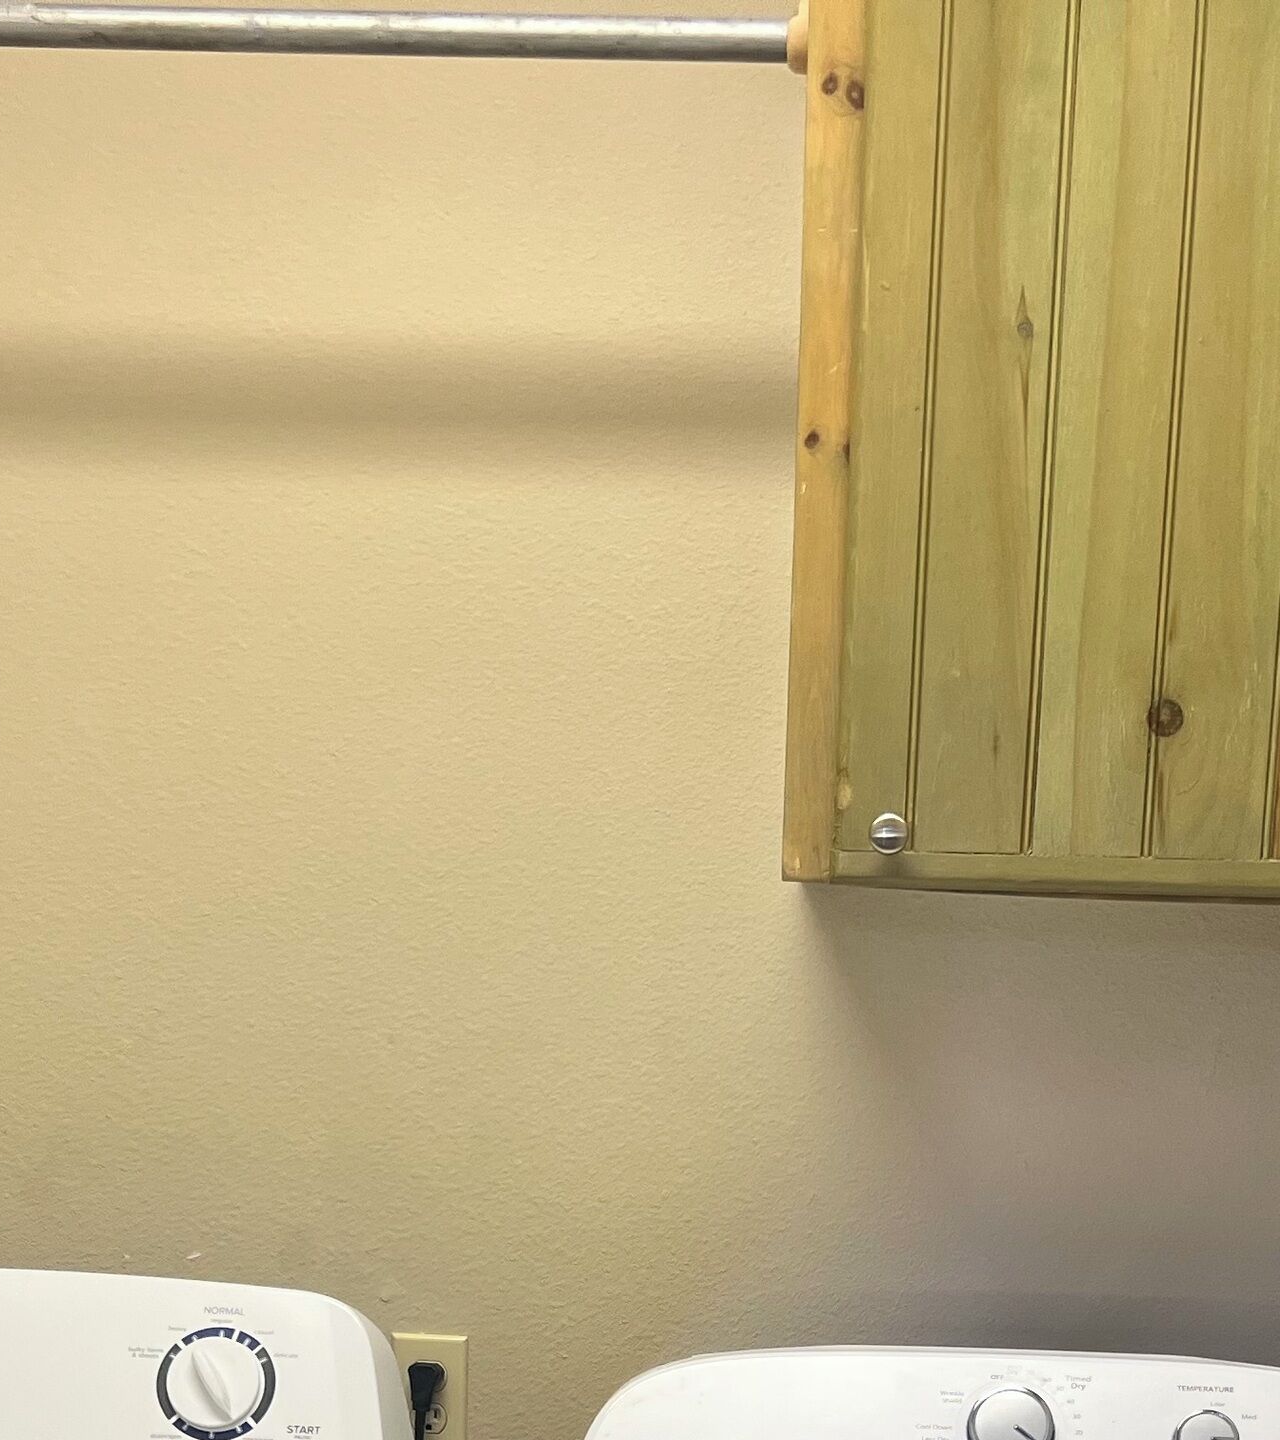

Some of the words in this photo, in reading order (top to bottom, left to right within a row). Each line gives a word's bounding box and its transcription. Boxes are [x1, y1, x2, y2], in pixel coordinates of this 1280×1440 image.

[204, 1306, 245, 1316] NORMAL
[1065, 1374, 1092, 1383] Timed
[1071, 1382, 1086, 1391] Dry
[1177, 1385, 1235, 1393] TEMPERATURE
[286, 1425, 321, 1435] START
